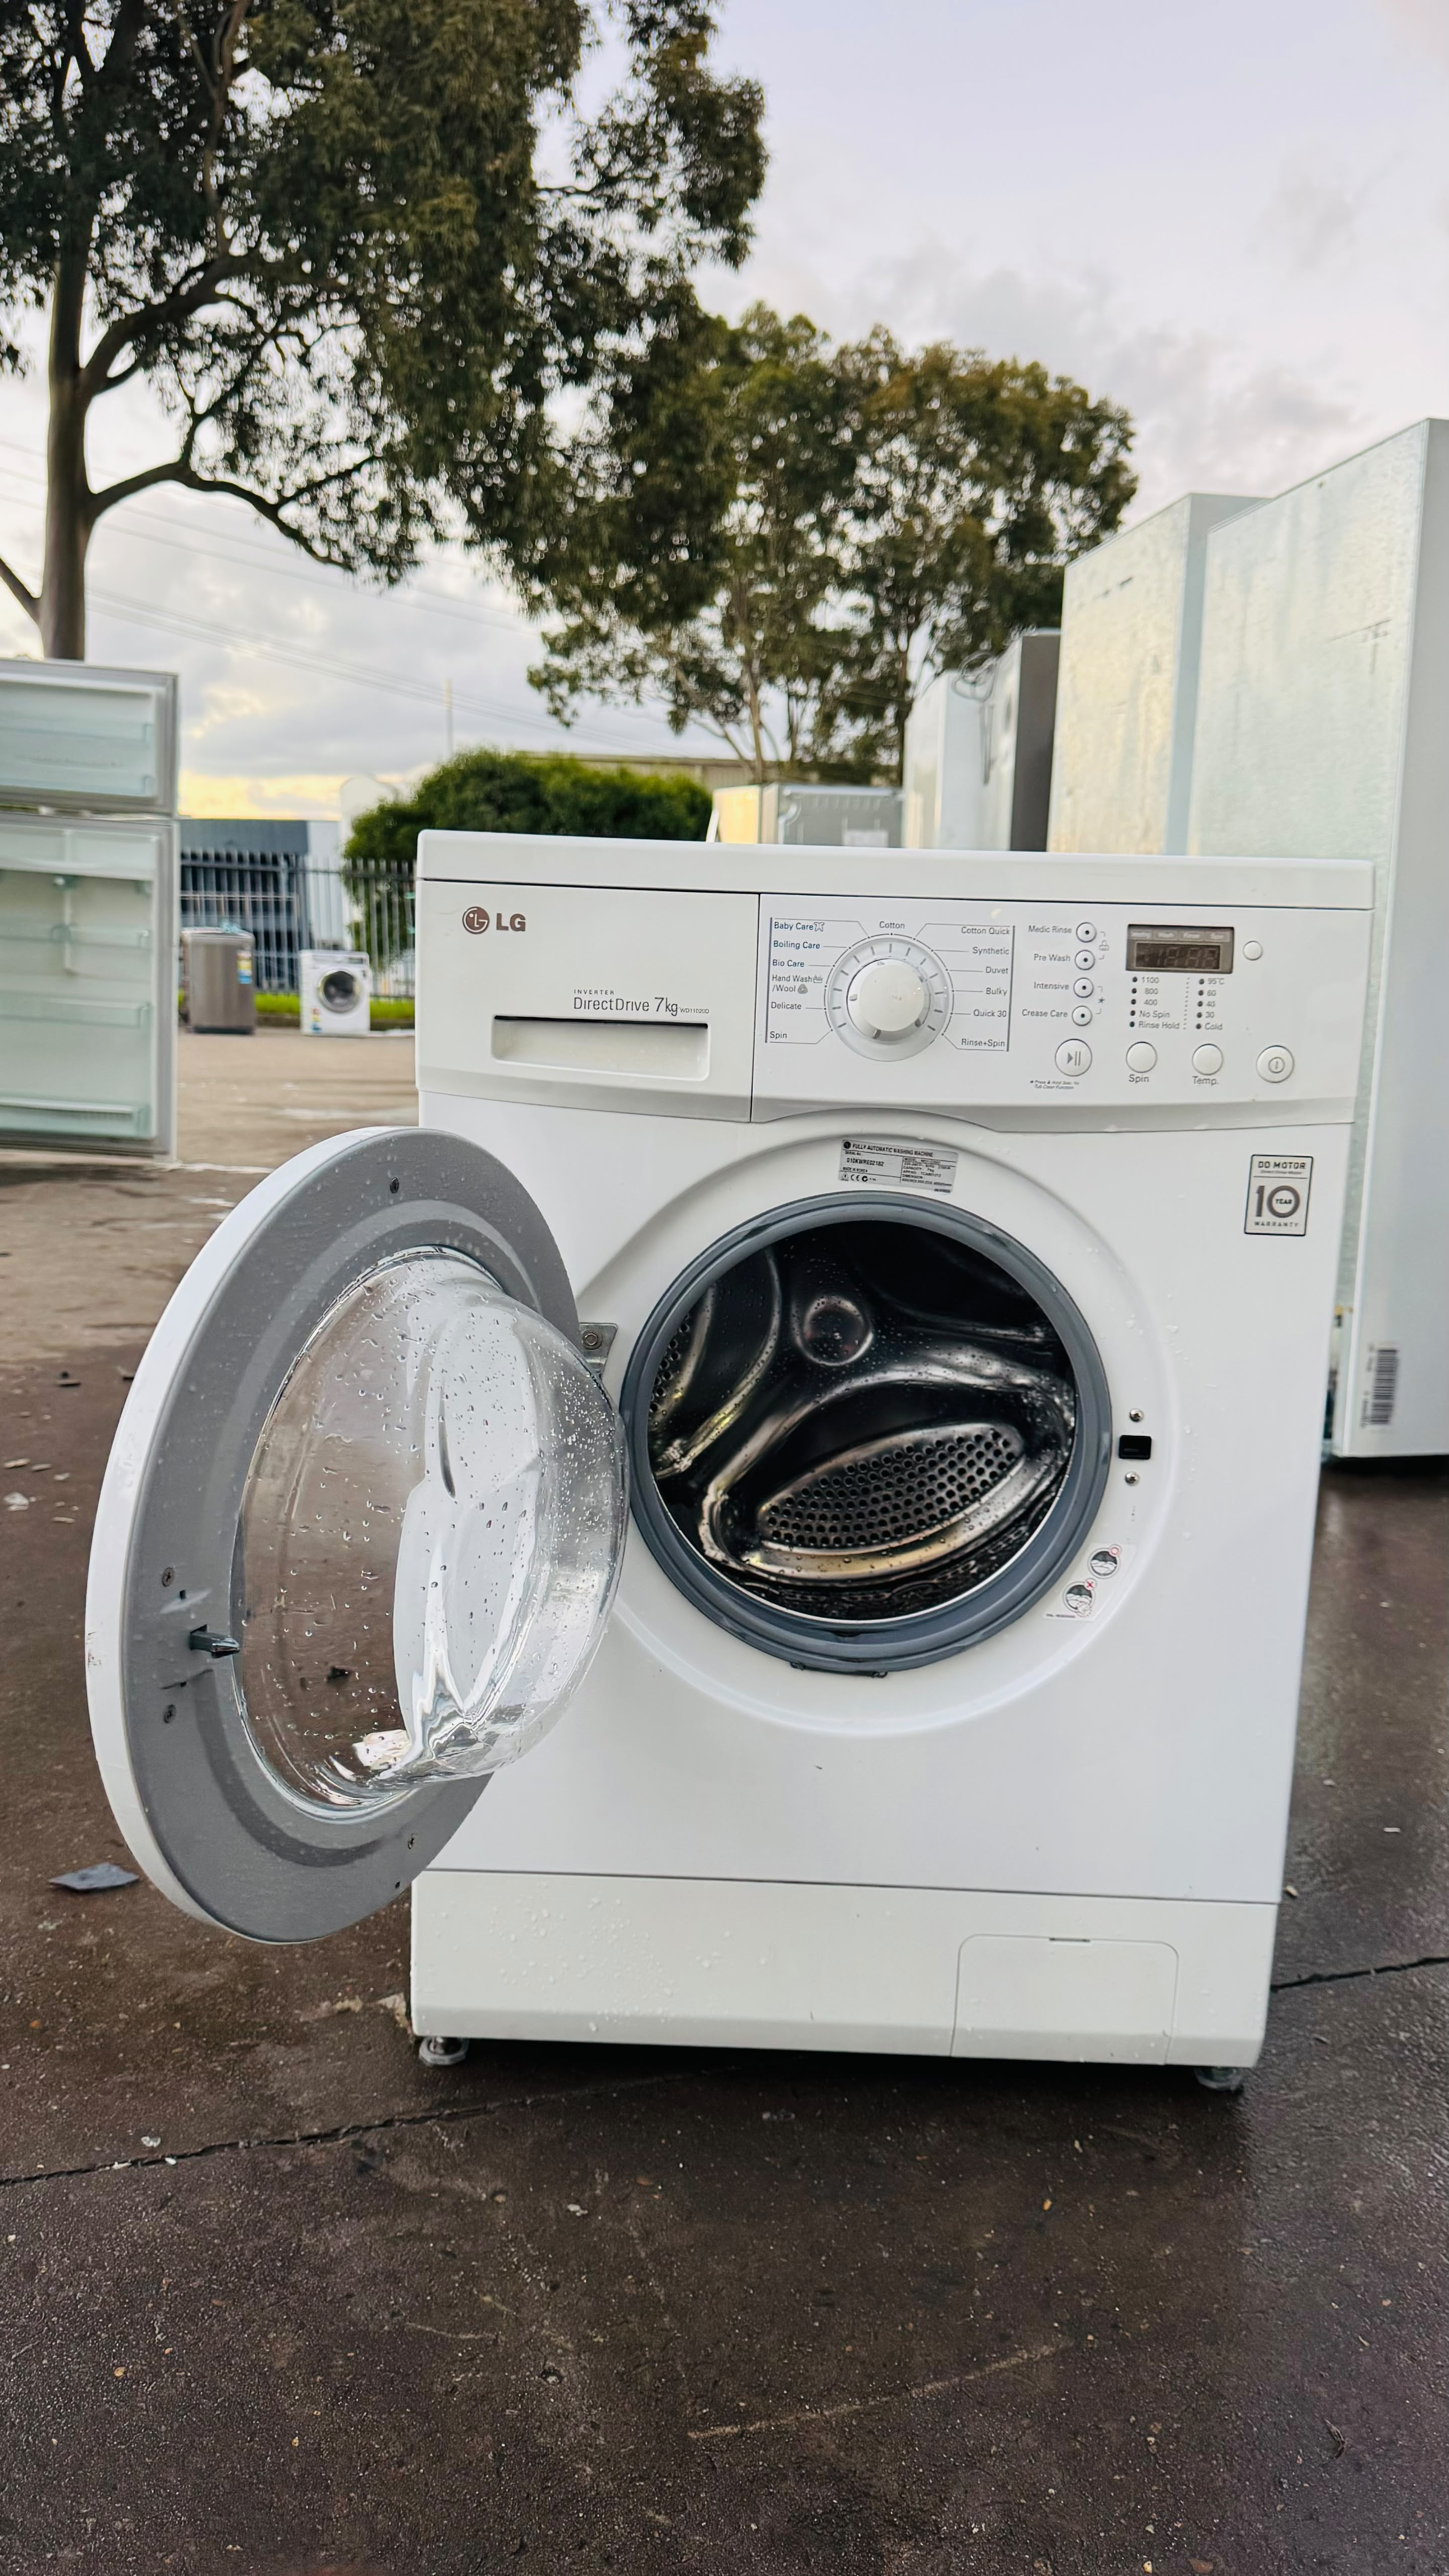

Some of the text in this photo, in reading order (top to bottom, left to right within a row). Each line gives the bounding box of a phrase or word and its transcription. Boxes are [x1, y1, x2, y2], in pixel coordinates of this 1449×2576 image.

[496, 913, 526, 932] LG
[774, 922, 793, 931] Baby
[773, 940, 800, 949] Boiling
[973, 946, 1009, 955] Synthetic
[986, 966, 1008, 974] Duvet
[1034, 982, 1069, 990] Intensive
[986, 987, 1007, 996] Bulky
[771, 1002, 801, 1010] Delicate
[1022, 1009, 1048, 1017] Crease
[1153, 1010, 1170, 1019] Spin
[770, 1031, 787, 1039] Spin
[1129, 1074, 1149, 1084] Spin
[1273, 1162, 1306, 1170] MOTOR
[1255, 1185, 1301, 1218] 10
